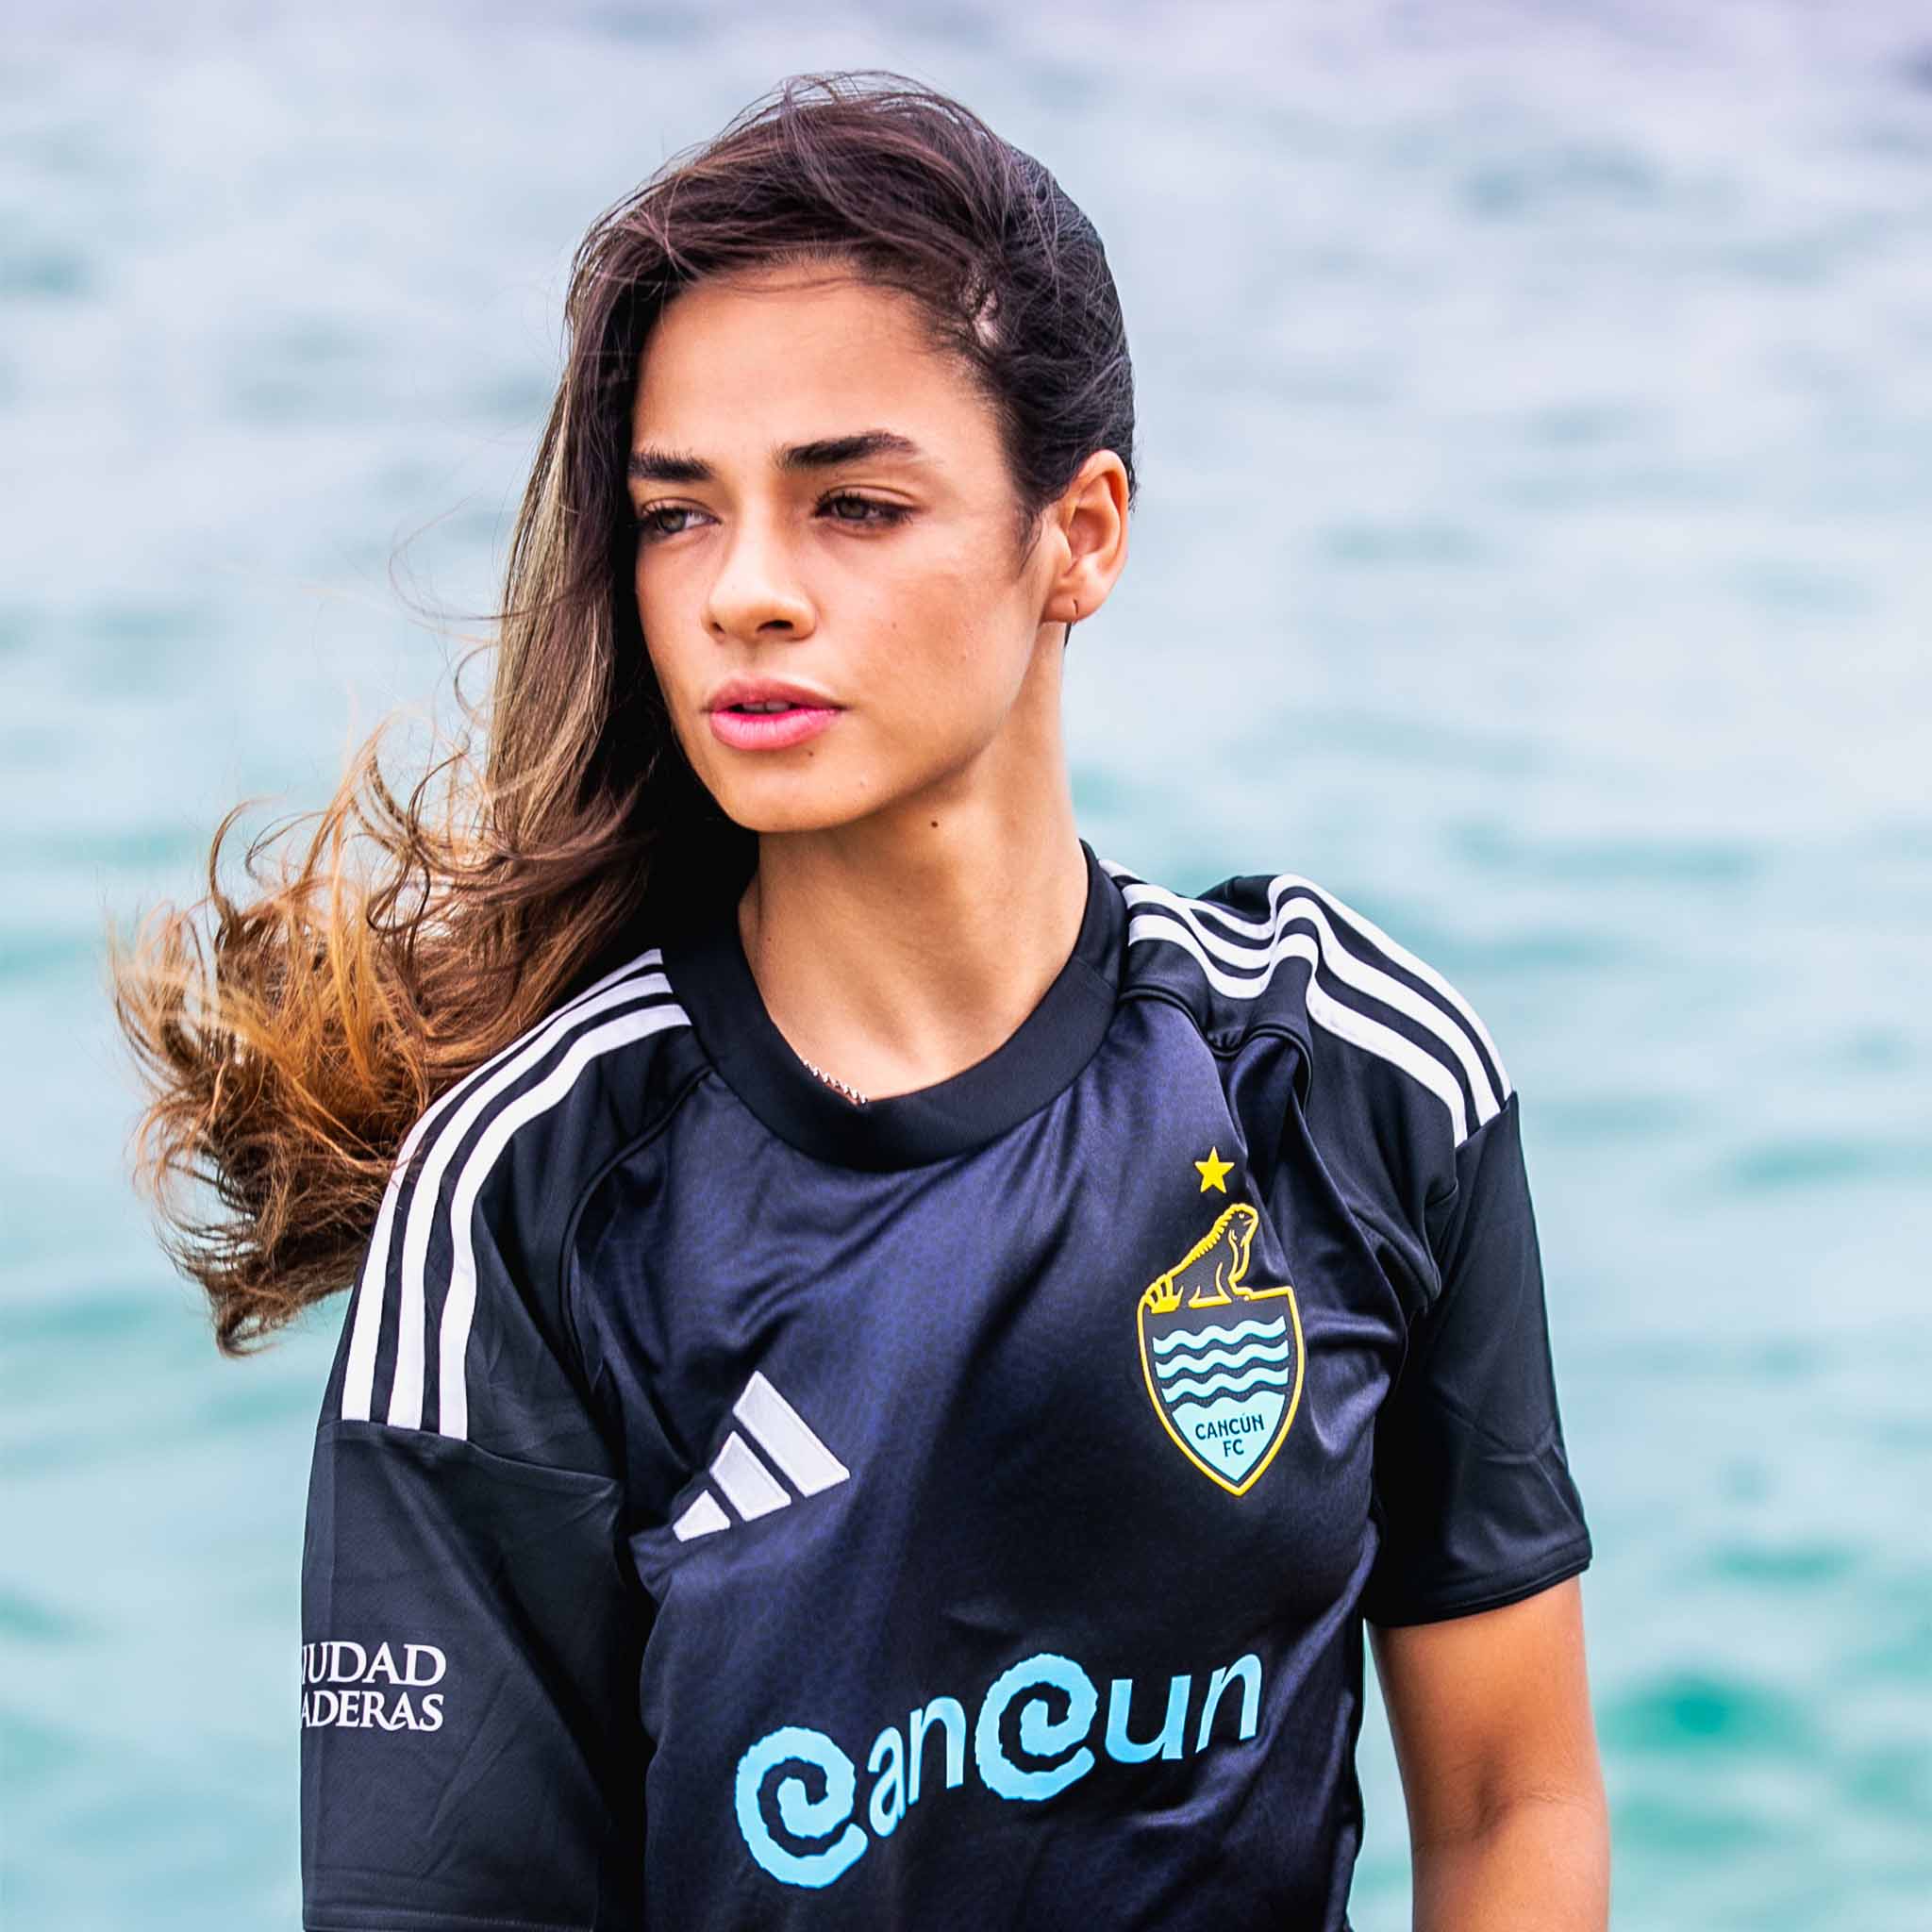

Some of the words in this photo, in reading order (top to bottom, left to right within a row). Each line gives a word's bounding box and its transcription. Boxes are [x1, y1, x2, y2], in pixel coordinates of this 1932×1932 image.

[1195, 1412, 1265, 1440] CANCÚN
[1223, 1439, 1244, 1457] FC
[301, 1641, 446, 1686] IUDAD
[301, 1690, 444, 1730] ADERAS
